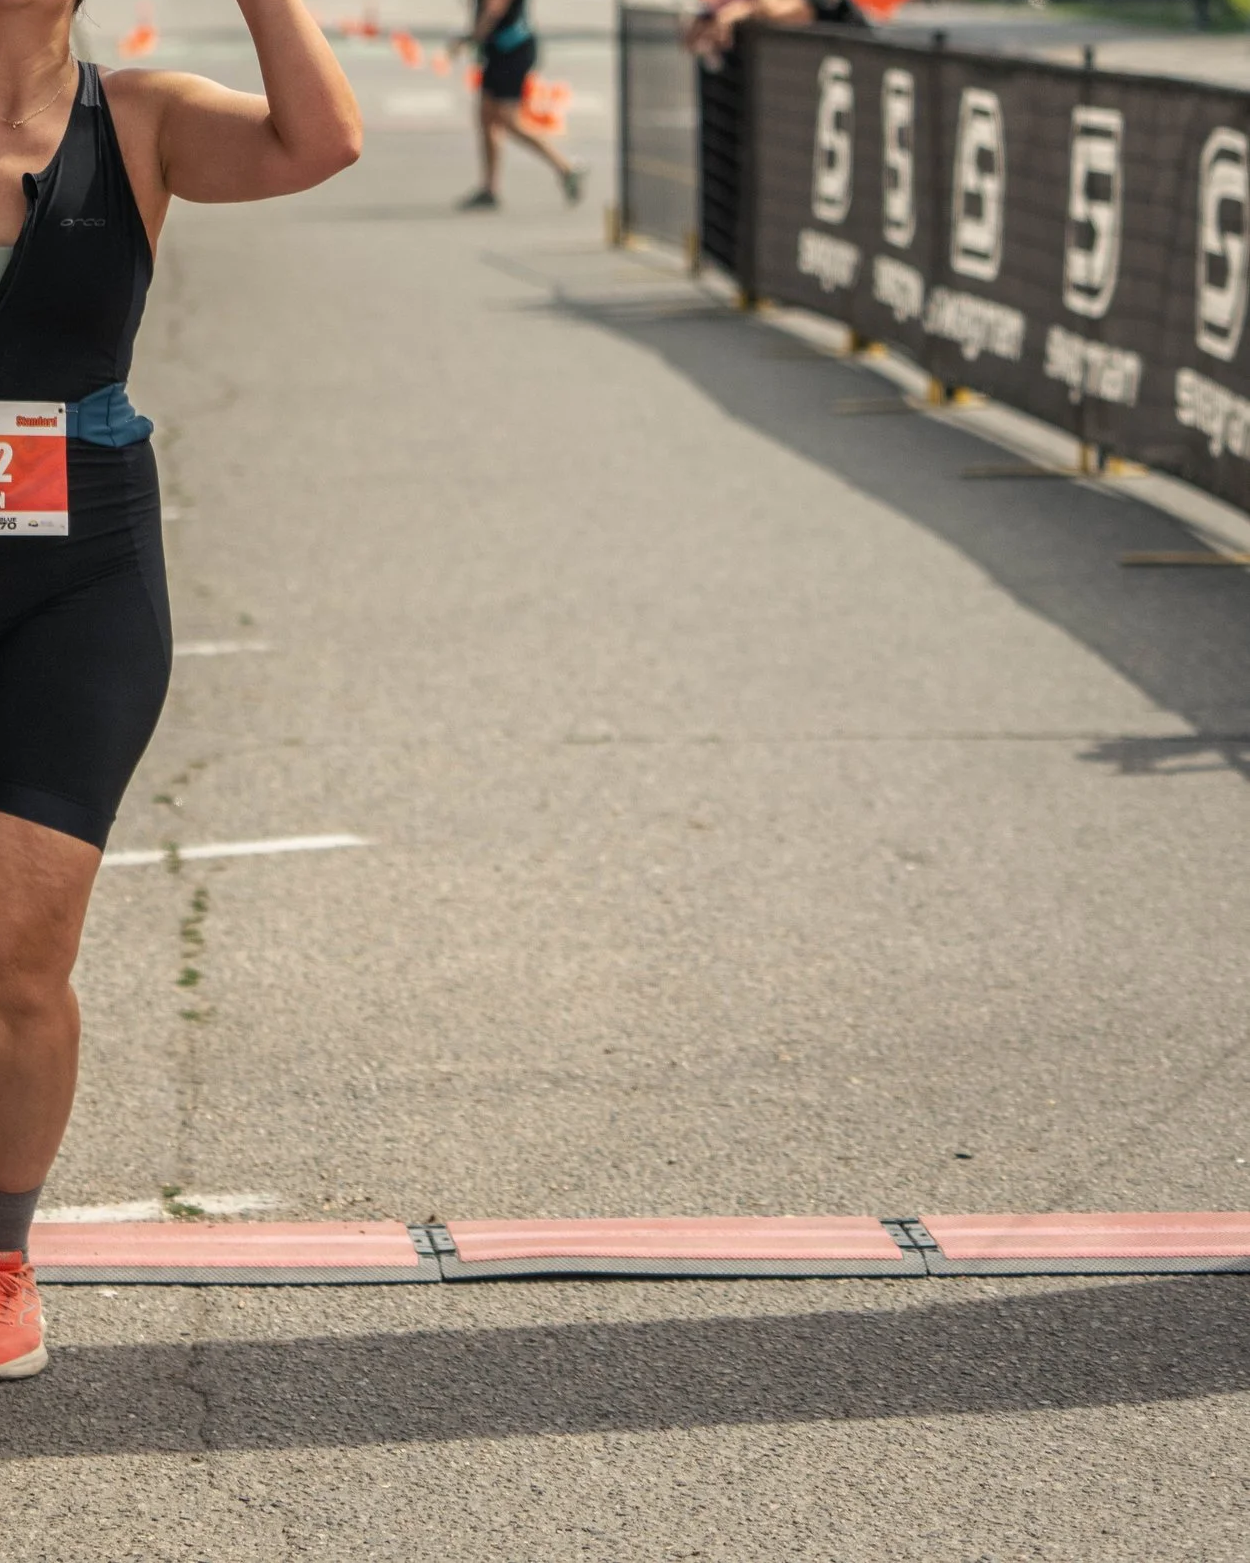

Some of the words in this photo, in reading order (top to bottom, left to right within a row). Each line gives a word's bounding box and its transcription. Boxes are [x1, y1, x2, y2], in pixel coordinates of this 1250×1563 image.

[60, 218, 106, 227] orca
[16, 415, 58, 427] Standard
[0, 522, 17, 530] 70
